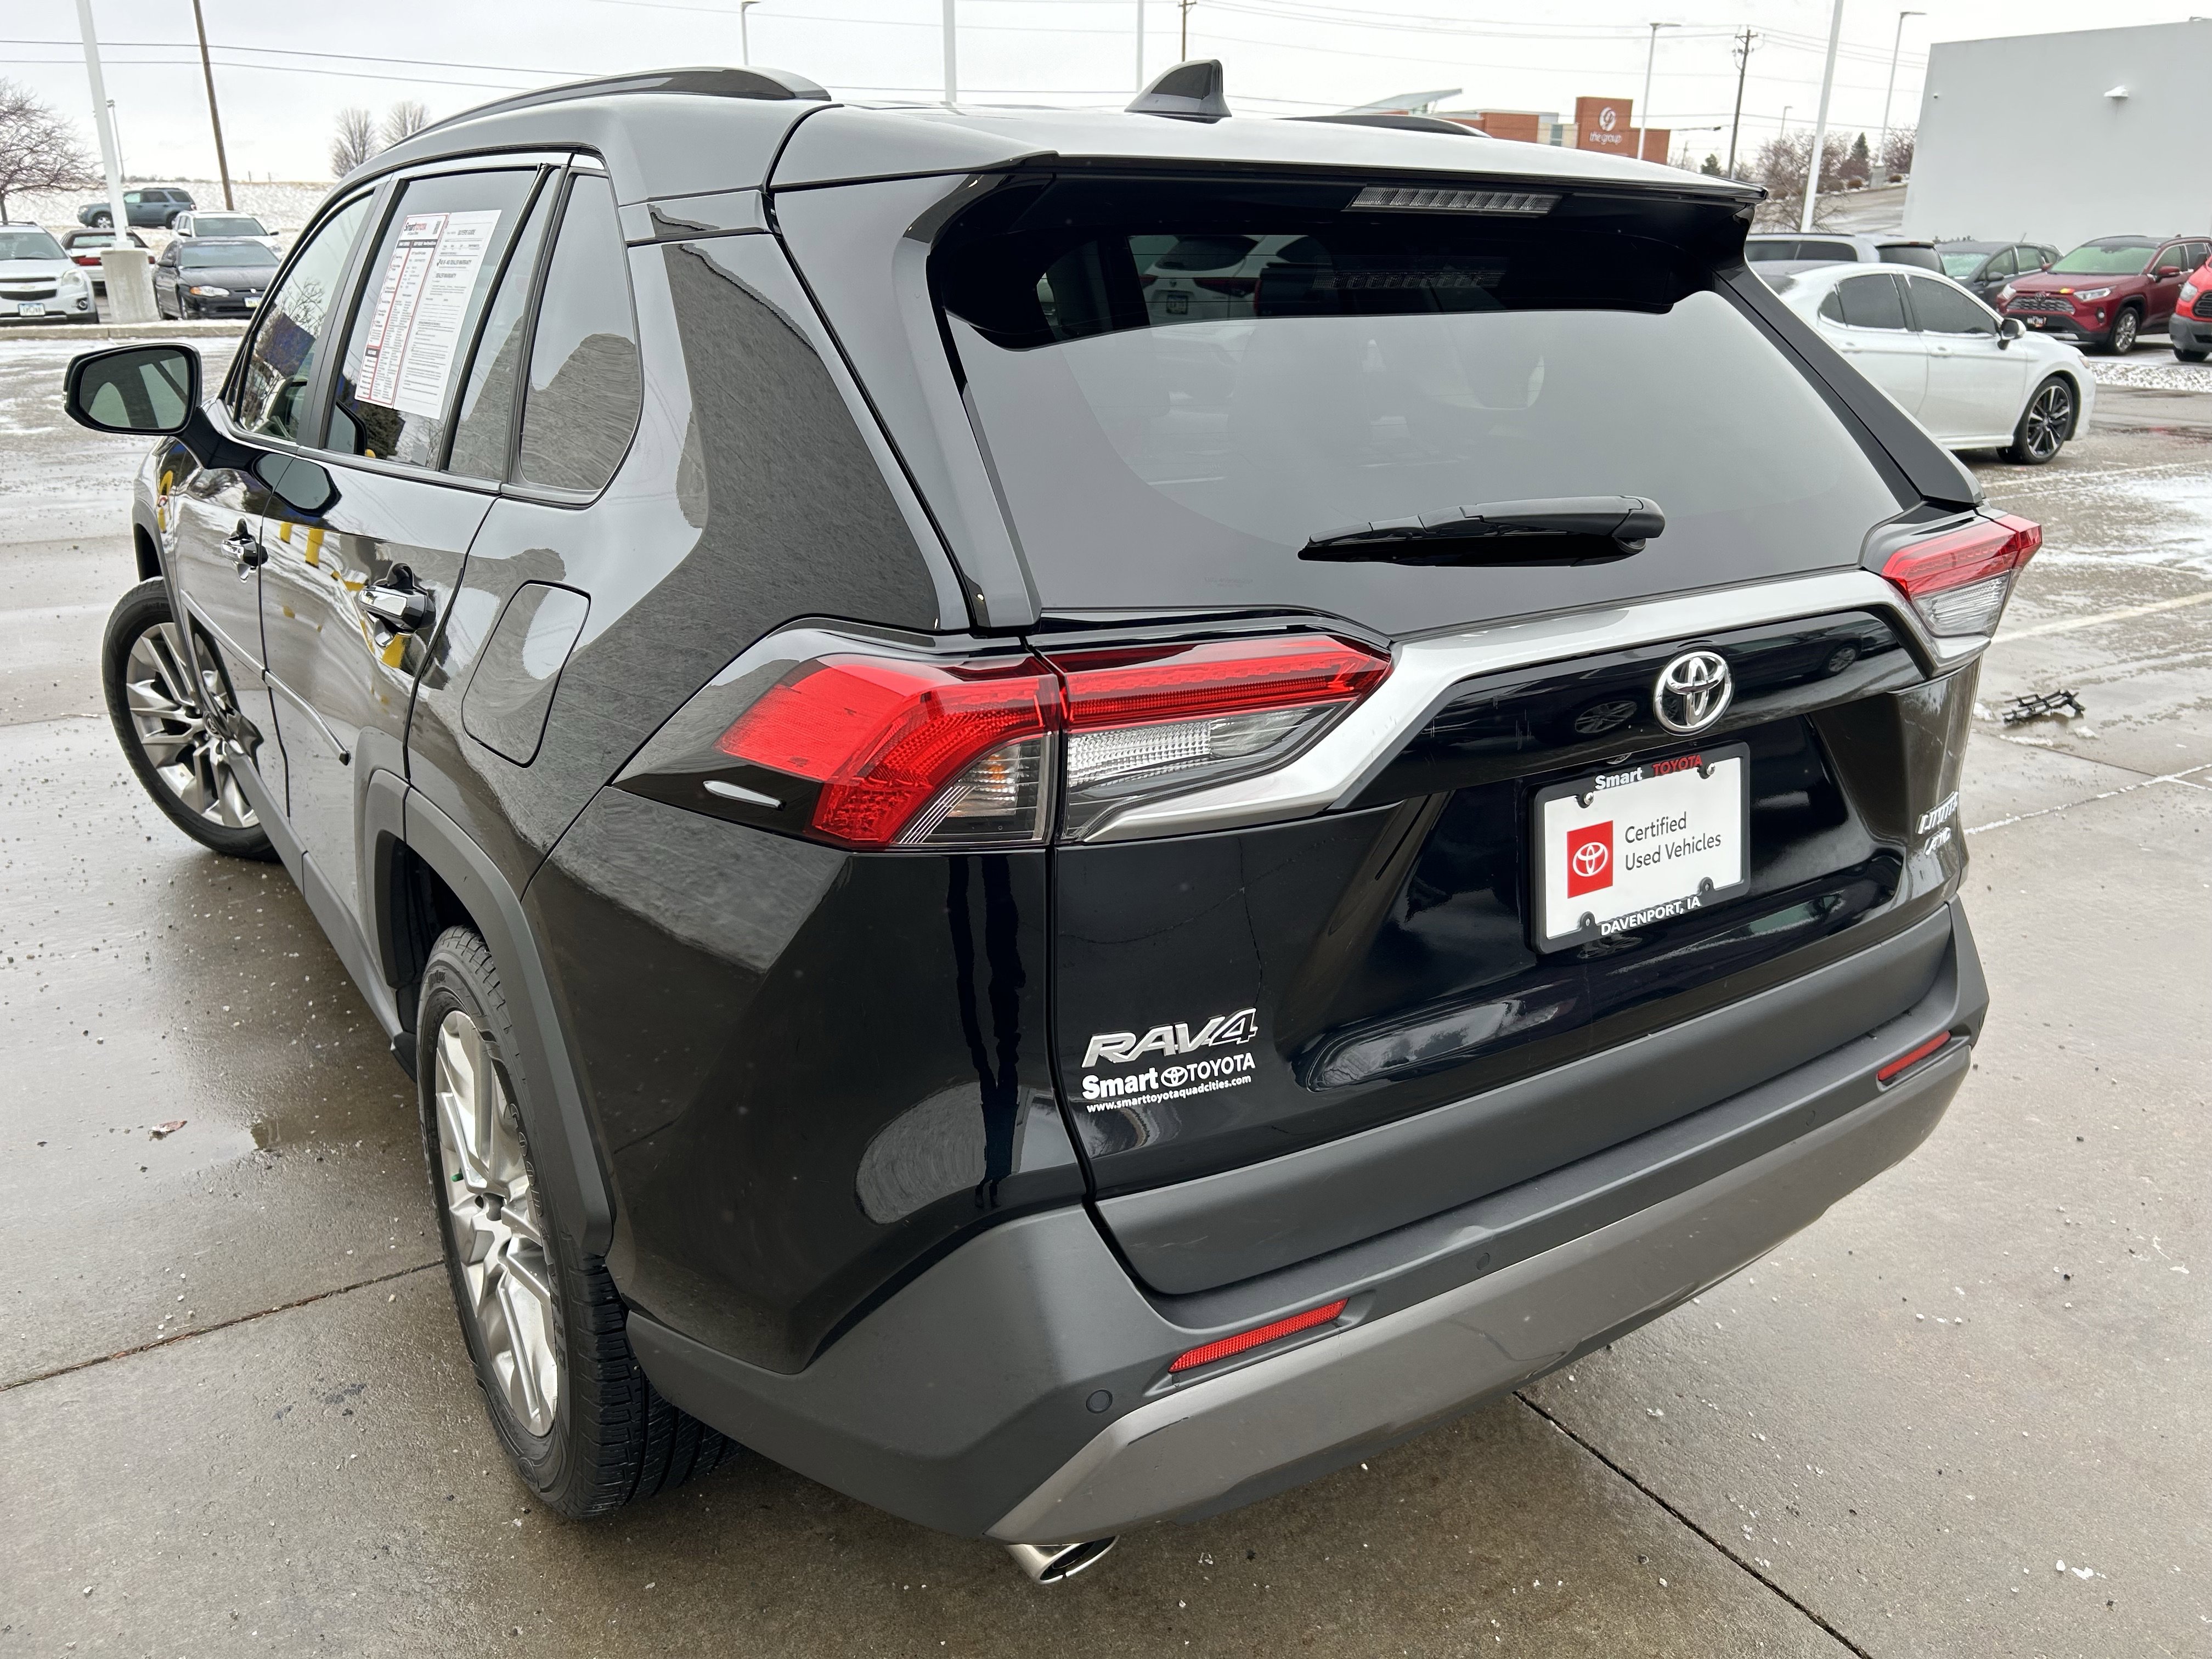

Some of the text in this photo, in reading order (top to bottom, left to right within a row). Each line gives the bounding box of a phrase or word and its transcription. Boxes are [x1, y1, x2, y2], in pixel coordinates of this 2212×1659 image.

[1595, 754, 1703, 790] Smart TOYOTA
[1624, 811, 1687, 843] Certified
[1625, 833, 1722, 871] Used Vehicles
[1601, 896, 1701, 936] DAVENPORT, IA
[1081, 1007, 1259, 1068] RAV4
[1082, 1052, 1256, 1099] Smart TOYOTA
[1086, 1074, 1252, 1113] www.smarttoyotaquadcities.com
